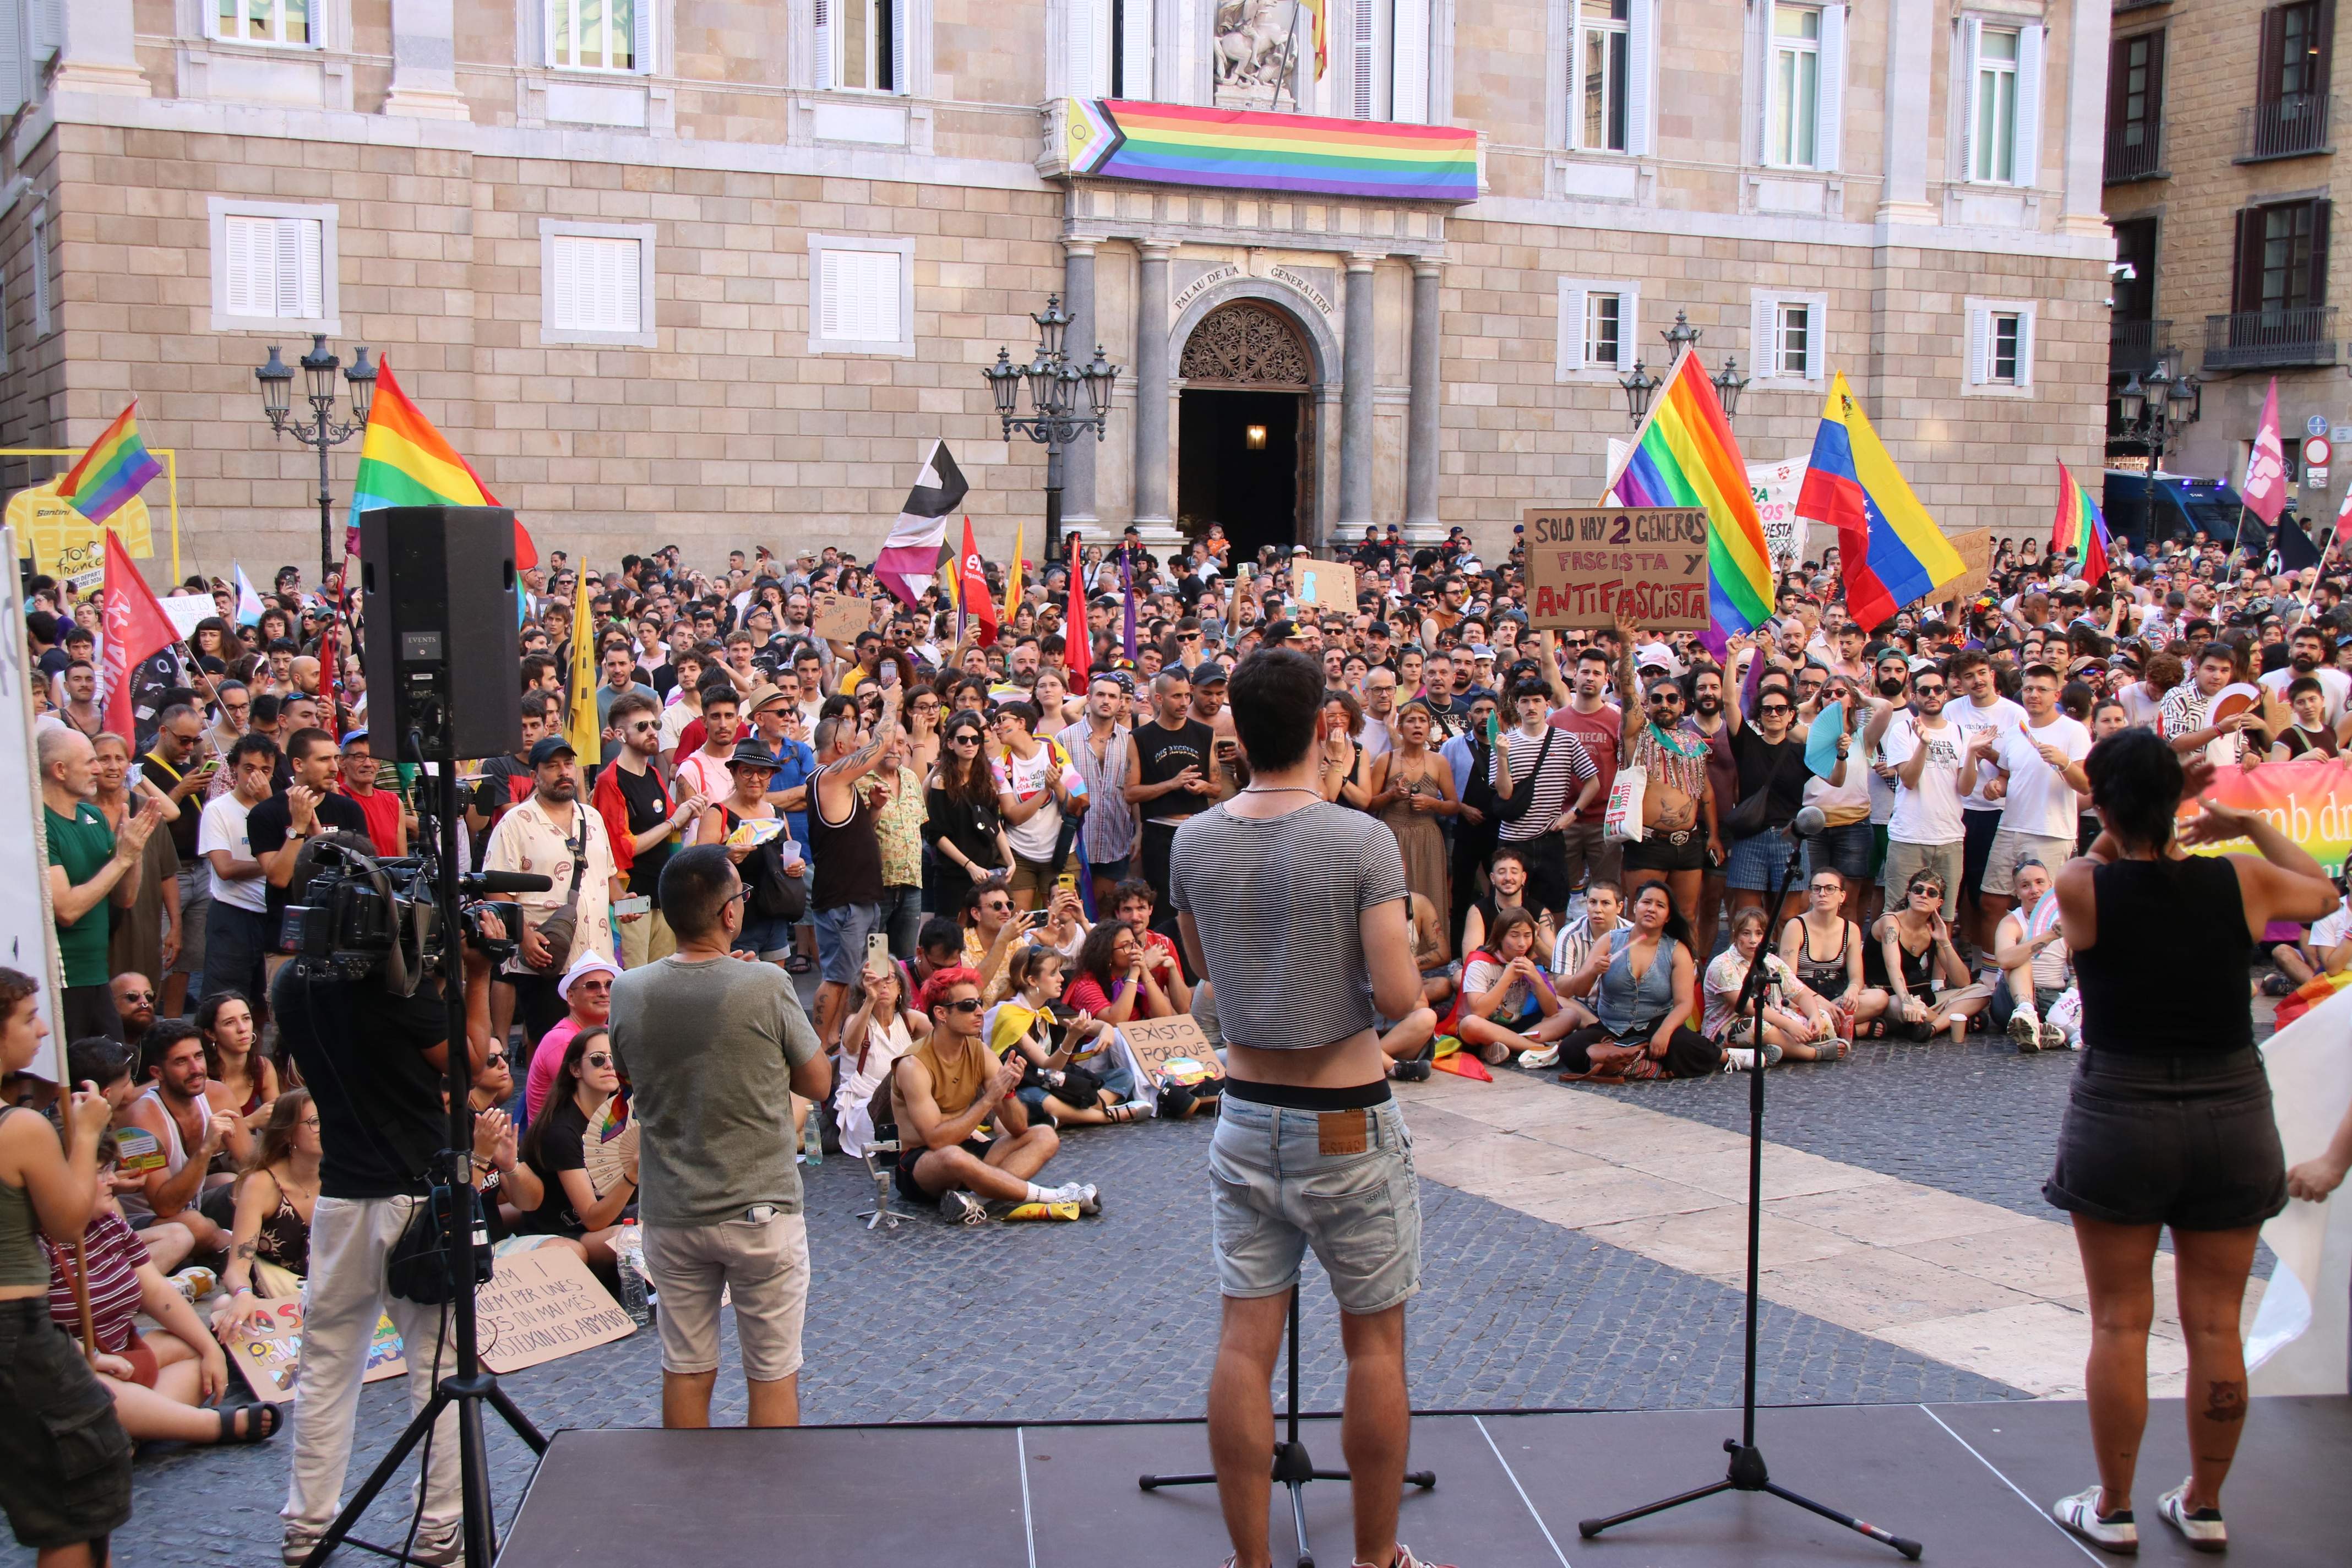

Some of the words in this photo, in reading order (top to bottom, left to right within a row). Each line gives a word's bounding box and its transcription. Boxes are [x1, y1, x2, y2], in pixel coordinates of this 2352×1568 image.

[1174, 279, 1206, 309] PALAU
[1208, 270, 1223, 284] DE
[1224, 265, 1239, 276] LA
[1271, 268, 1333, 314] GENERALITAT
[1536, 517, 1574, 543] SOLO
[1580, 516, 1607, 541] HAY
[1609, 516, 1631, 544] 2
[1636, 512, 1706, 545] GÉNEROS
[61, 541, 100, 563] TOUR
[56, 557, 105, 578] france
[1558, 552, 1669, 571] FASCISTA
[1683, 554, 1703, 575] Y
[90, 577, 102, 586] 2026
[832, 618, 863, 637] DESEO
[1140, 1042, 1207, 1062] PORQUE
[510, 1288, 541, 1305] PER
[539, 1278, 584, 1296] UNES
[513, 1310, 538, 1327] ON
